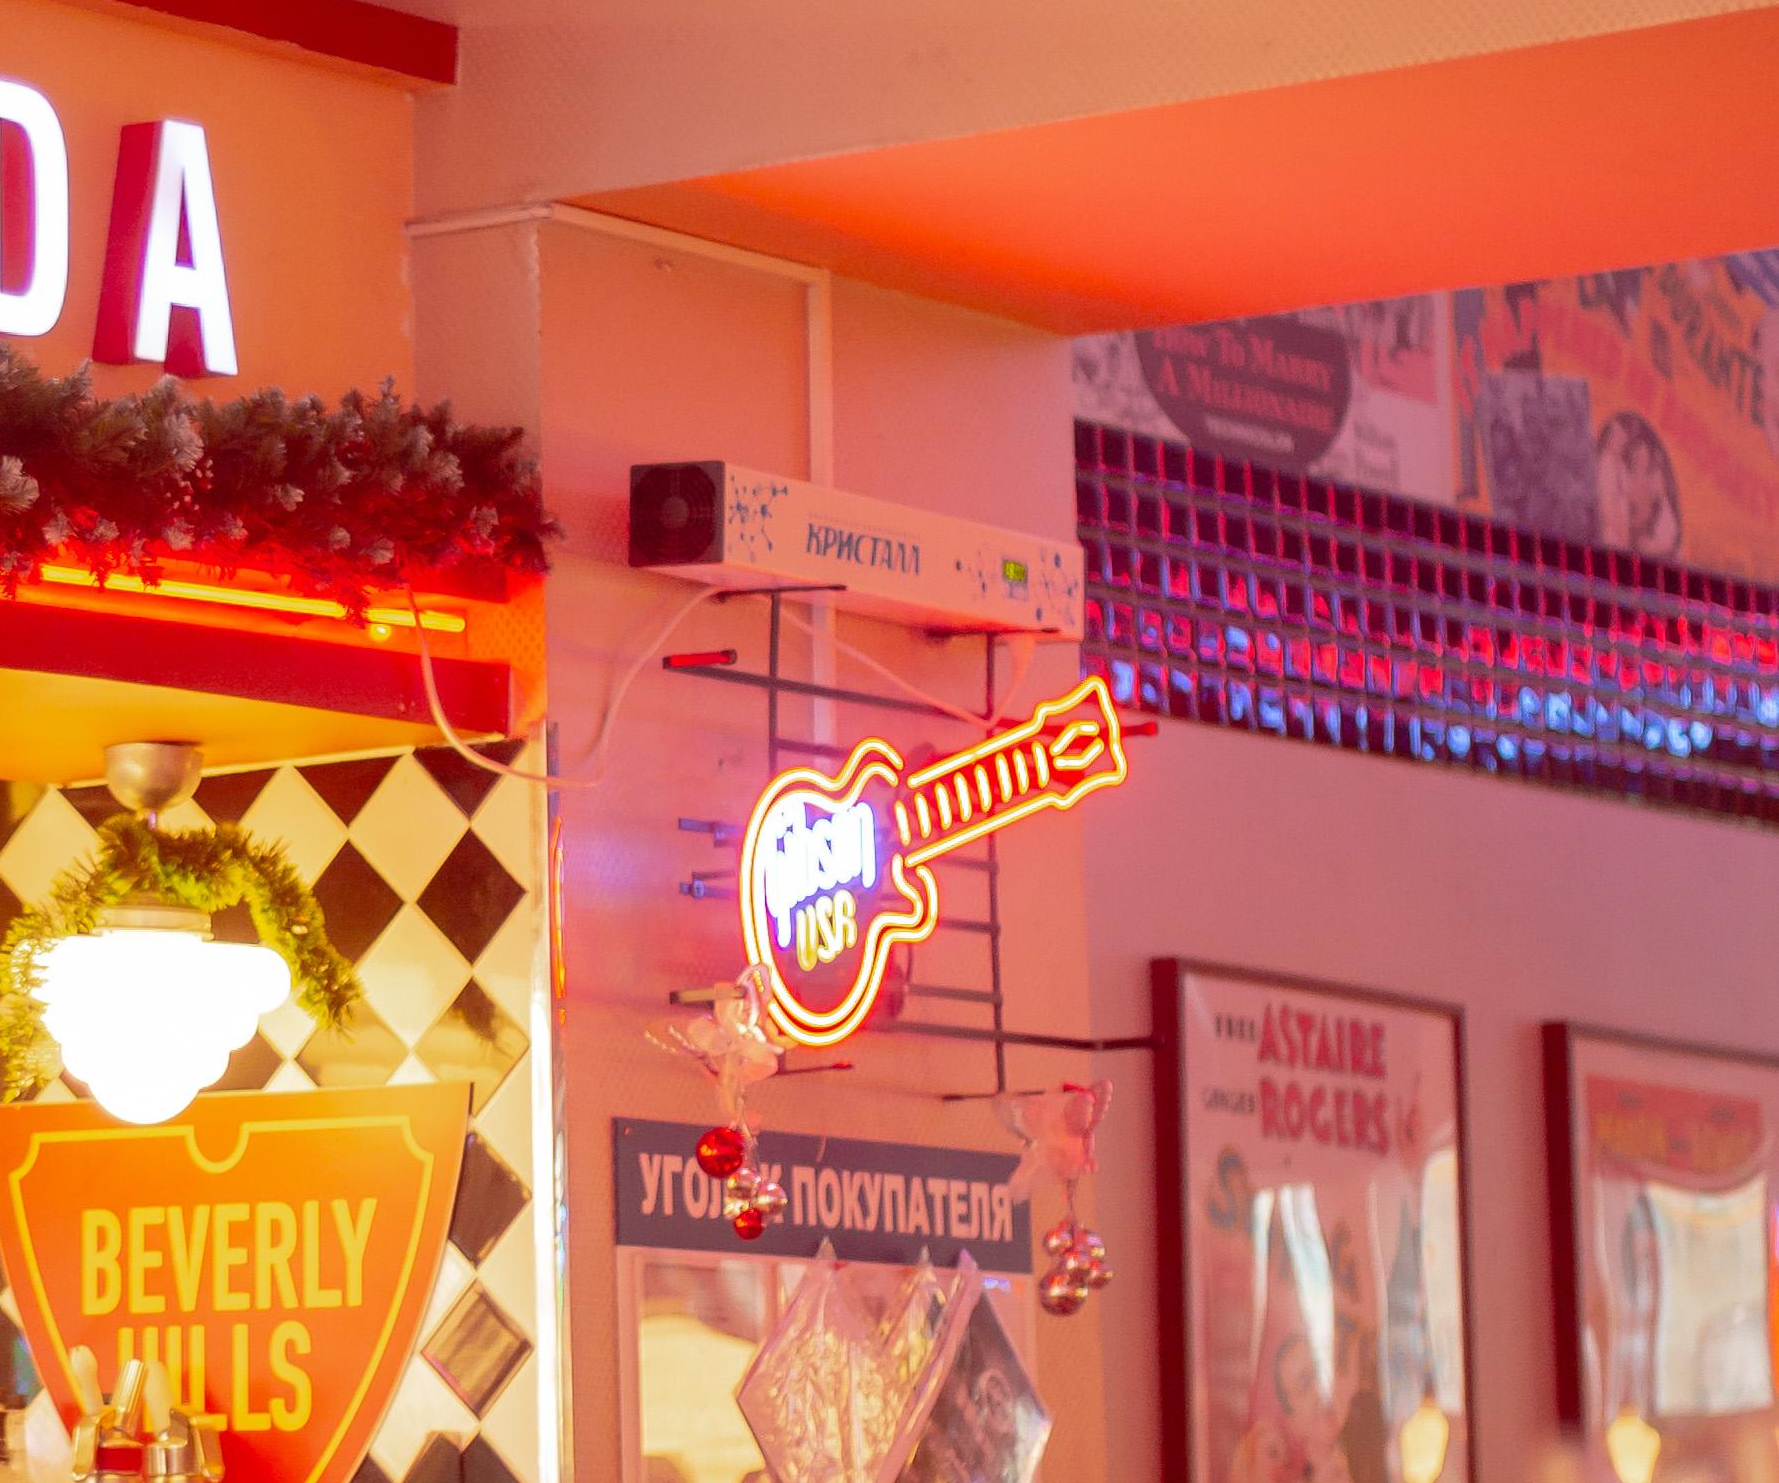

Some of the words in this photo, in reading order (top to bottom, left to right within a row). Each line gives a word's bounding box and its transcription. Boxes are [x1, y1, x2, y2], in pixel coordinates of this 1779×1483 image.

[805, 522, 920, 575] КРИСТАЛЛ
[1258, 1003, 1387, 1080] ASTAIRE
[1259, 1076, 1389, 1158] ROGERS
[791, 1165, 1014, 1243] ПОКУПАТЕЛЯ
[81, 1197, 378, 1316] BEVERLY
